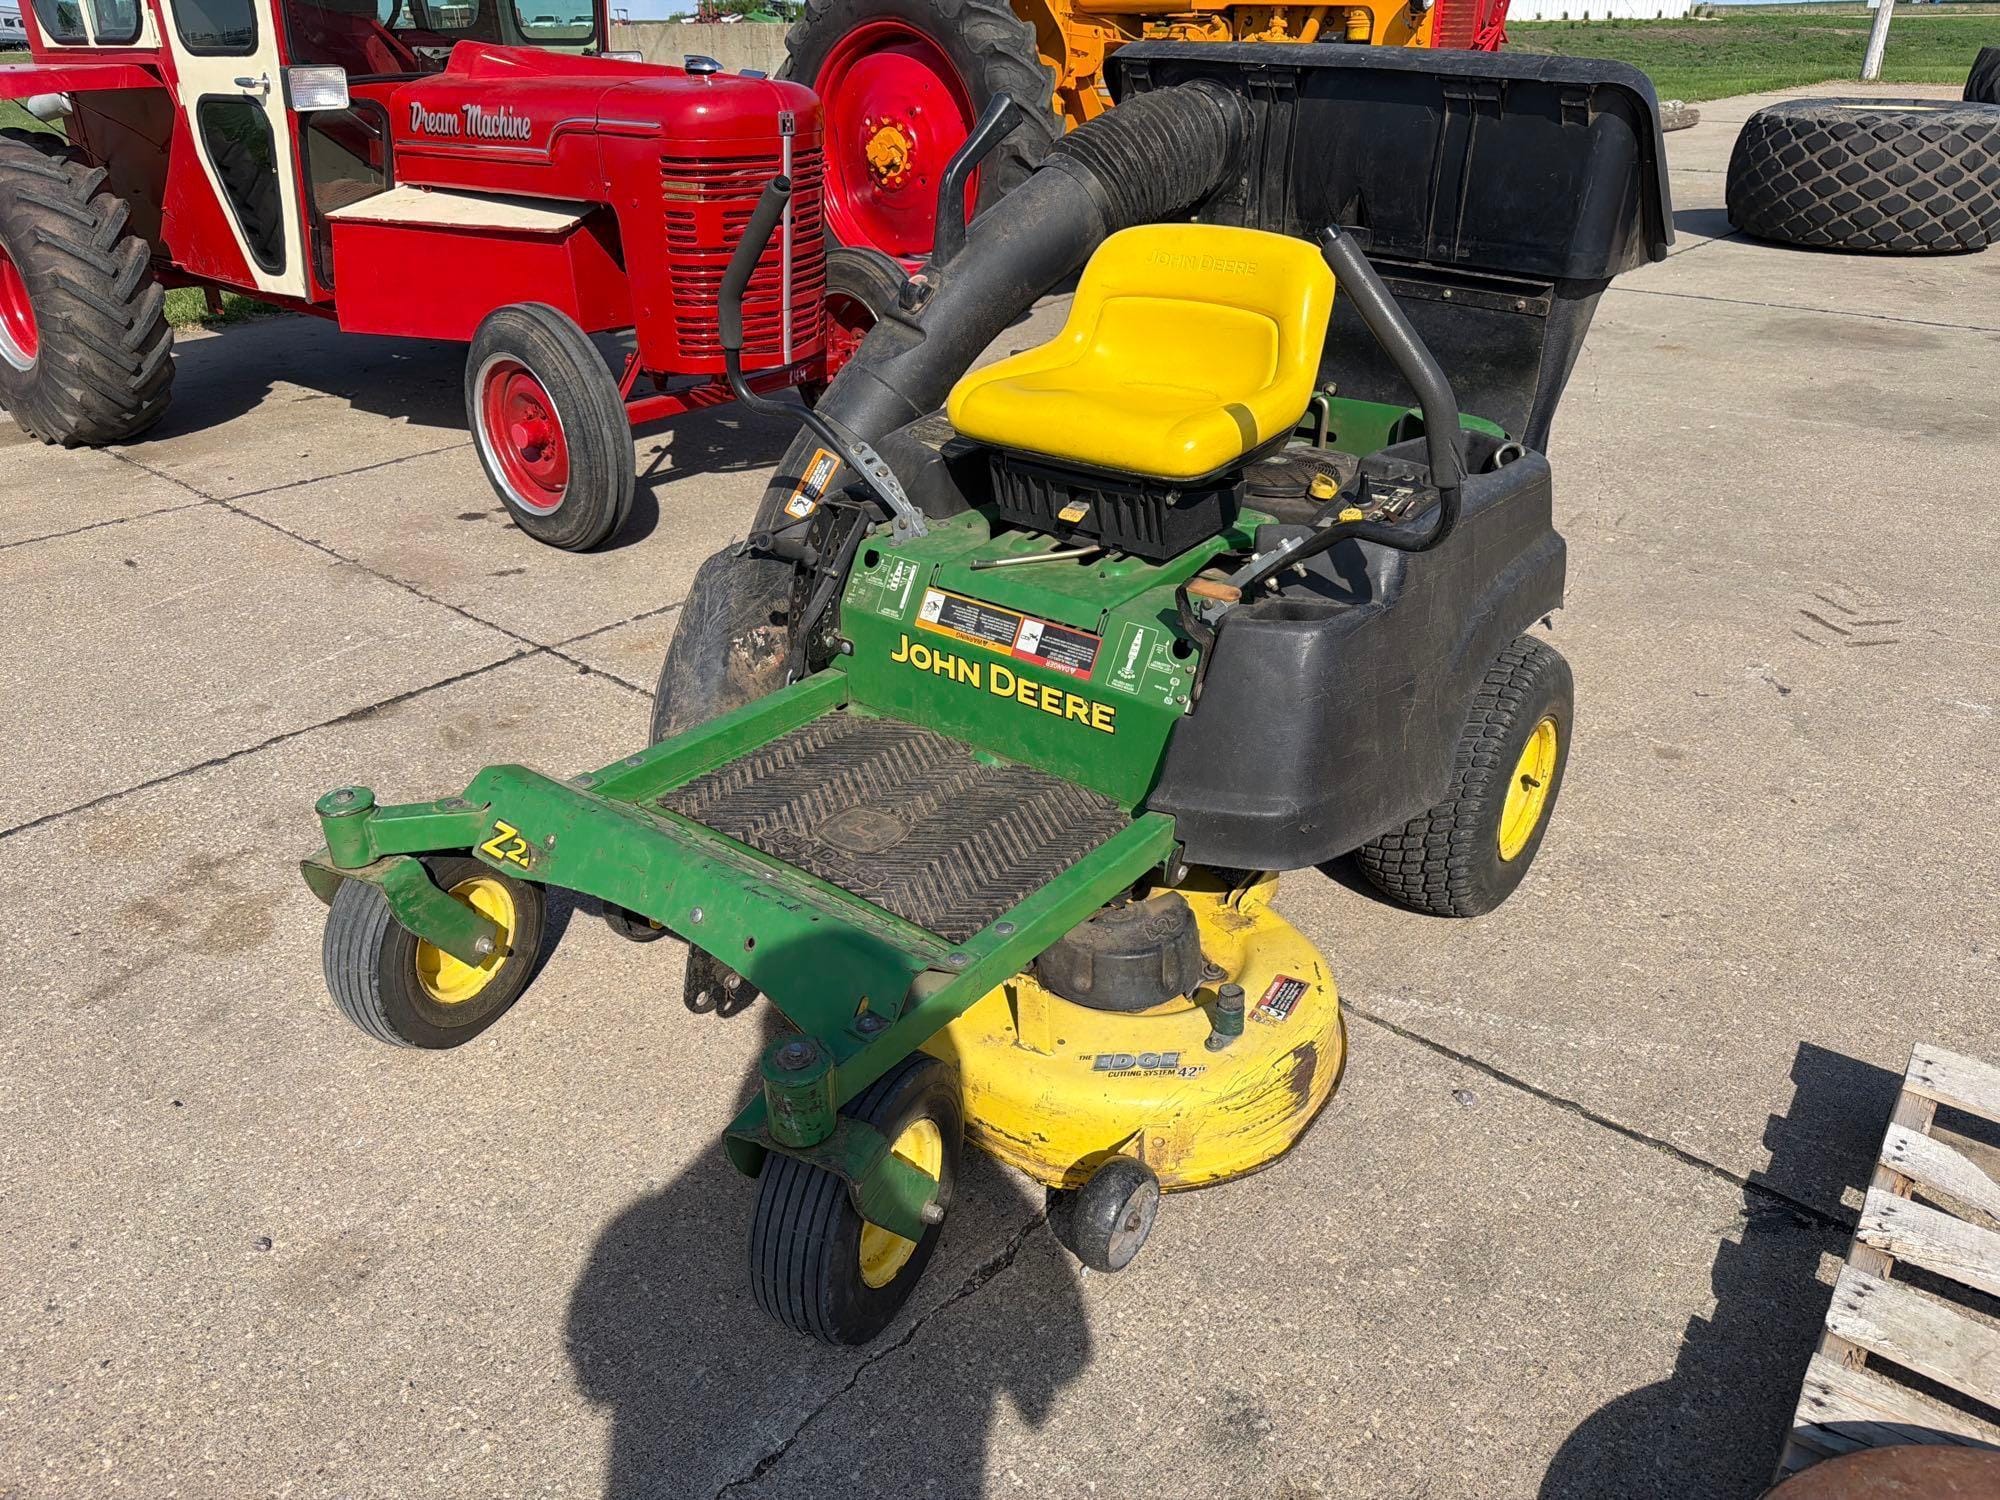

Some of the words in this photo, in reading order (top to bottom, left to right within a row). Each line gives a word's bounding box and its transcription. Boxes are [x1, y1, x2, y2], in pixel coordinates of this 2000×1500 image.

[410, 101, 460, 136] Dream
[461, 103, 532, 140] Machine
[1145, 248, 1197, 271] JOHN
[1198, 254, 1258, 276] DEERE
[1045, 659, 1071, 674] DANGER
[891, 633, 982, 689] JOHN
[988, 661, 1116, 735] DEERE
[762, 828, 815, 855] JOHN
[1093, 1051, 1180, 1071] EDGE
[1108, 1070, 1142, 1078] CUTTING
[1143, 1069, 1176, 1077] SYSTEM
[1177, 1066, 1206, 1077] 42"
